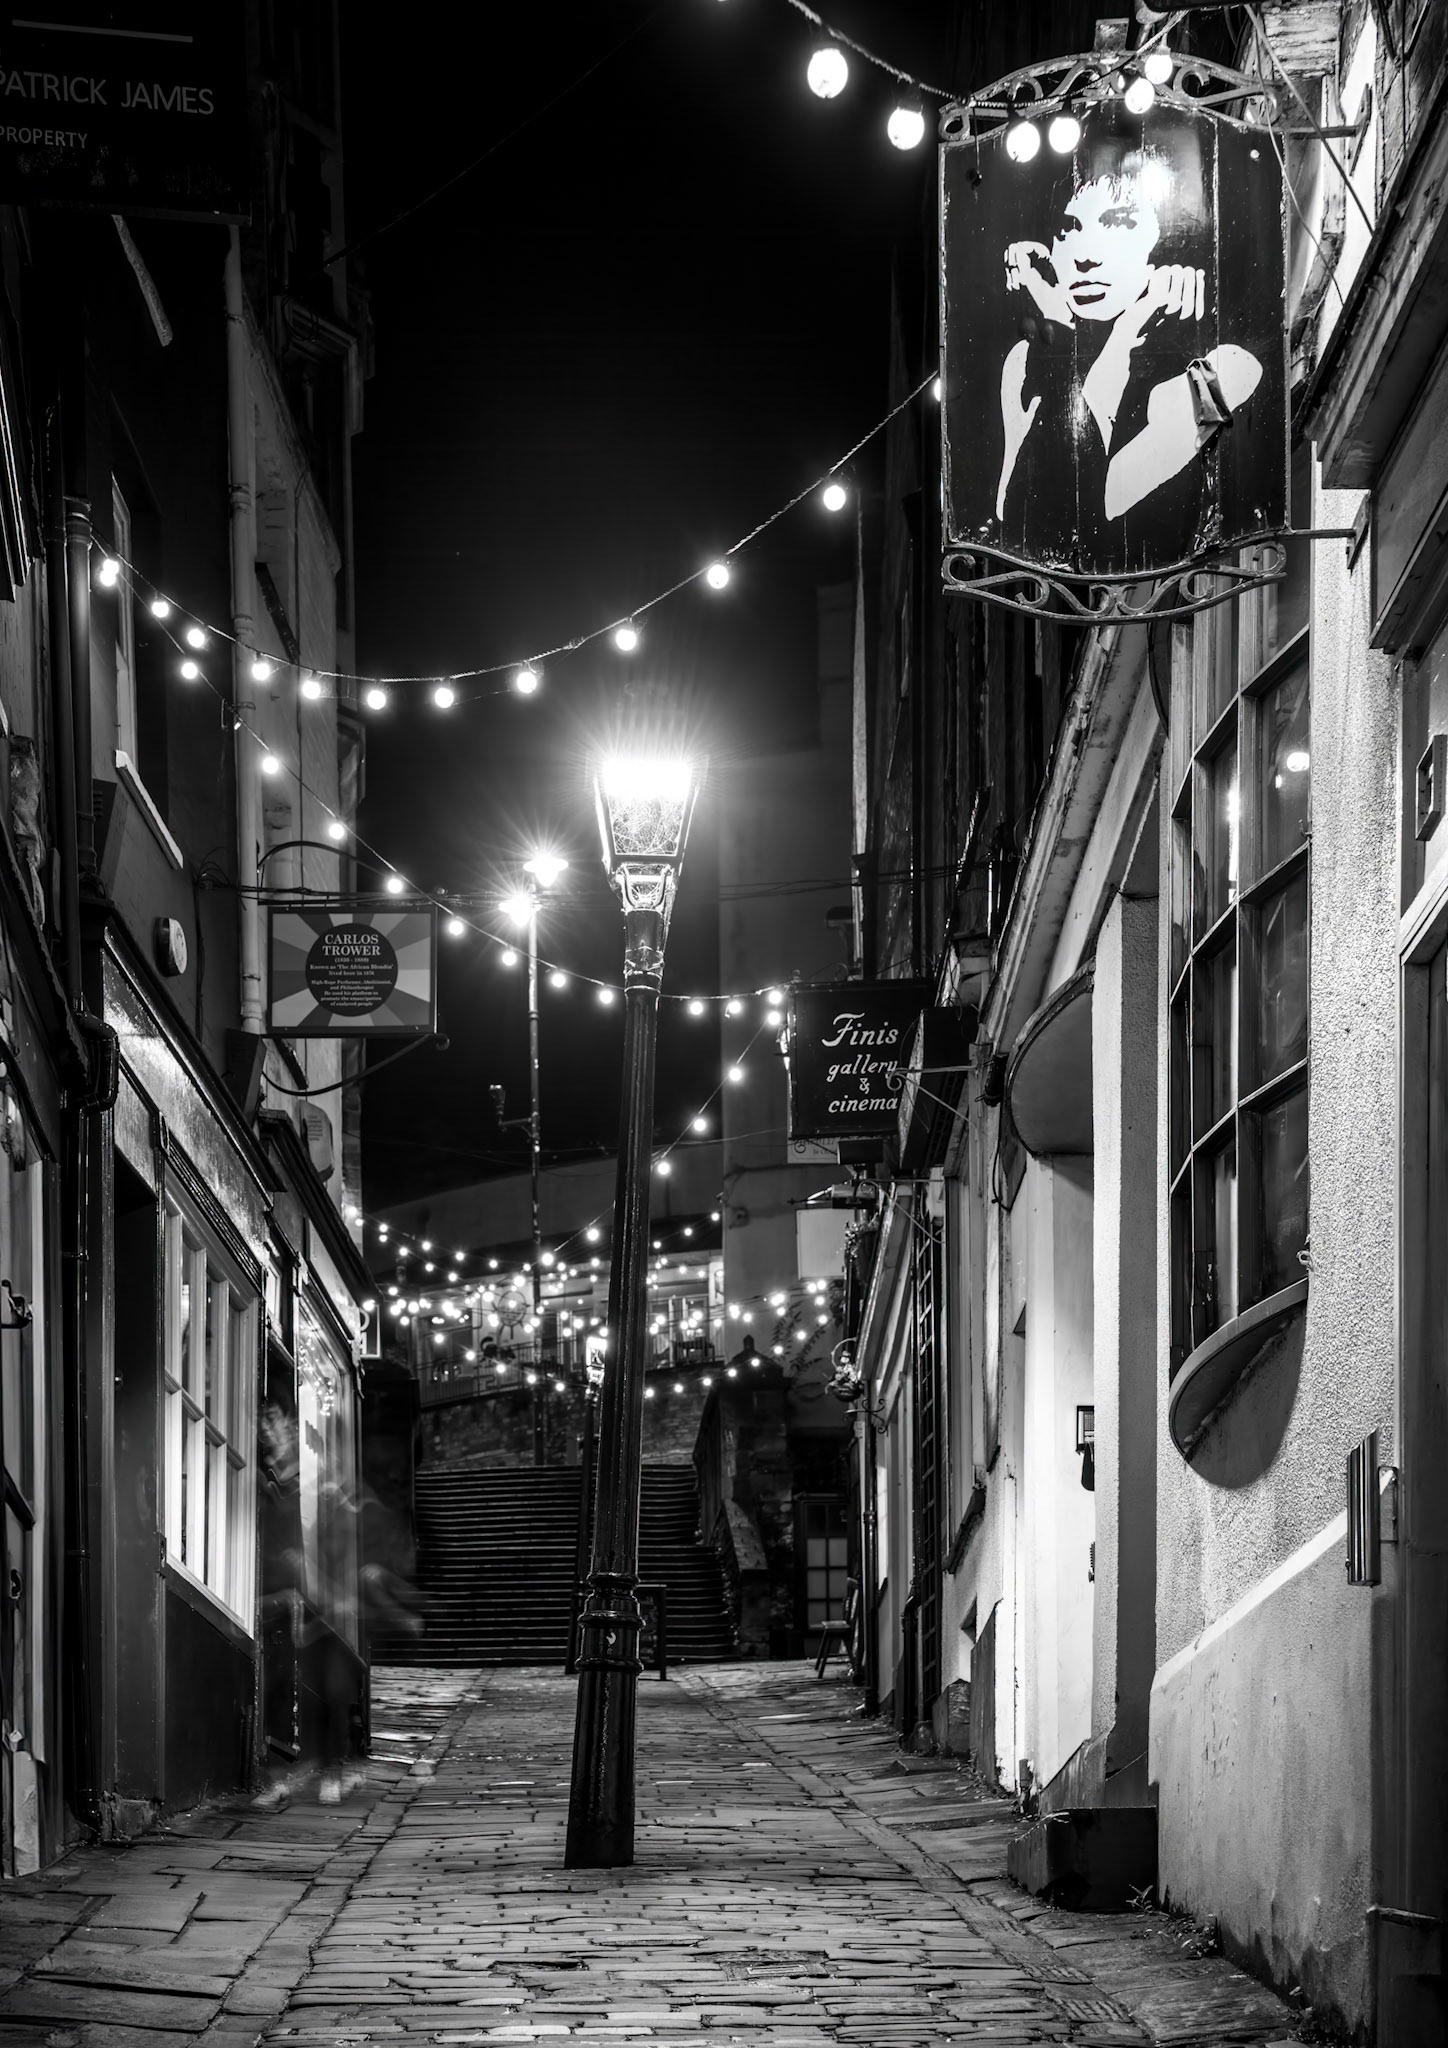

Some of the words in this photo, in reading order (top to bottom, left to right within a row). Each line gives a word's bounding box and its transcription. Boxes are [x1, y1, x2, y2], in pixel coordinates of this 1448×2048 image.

[120, 80, 215, 116] JAMES
[324, 933, 379, 945] CARLOS
[322, 945, 381, 956] TROWER
[821, 1012, 900, 1047] Finis
[826, 1054, 899, 1083] gallery
[858, 1077, 871, 1094] &
[827, 1095, 899, 1113] cinema
